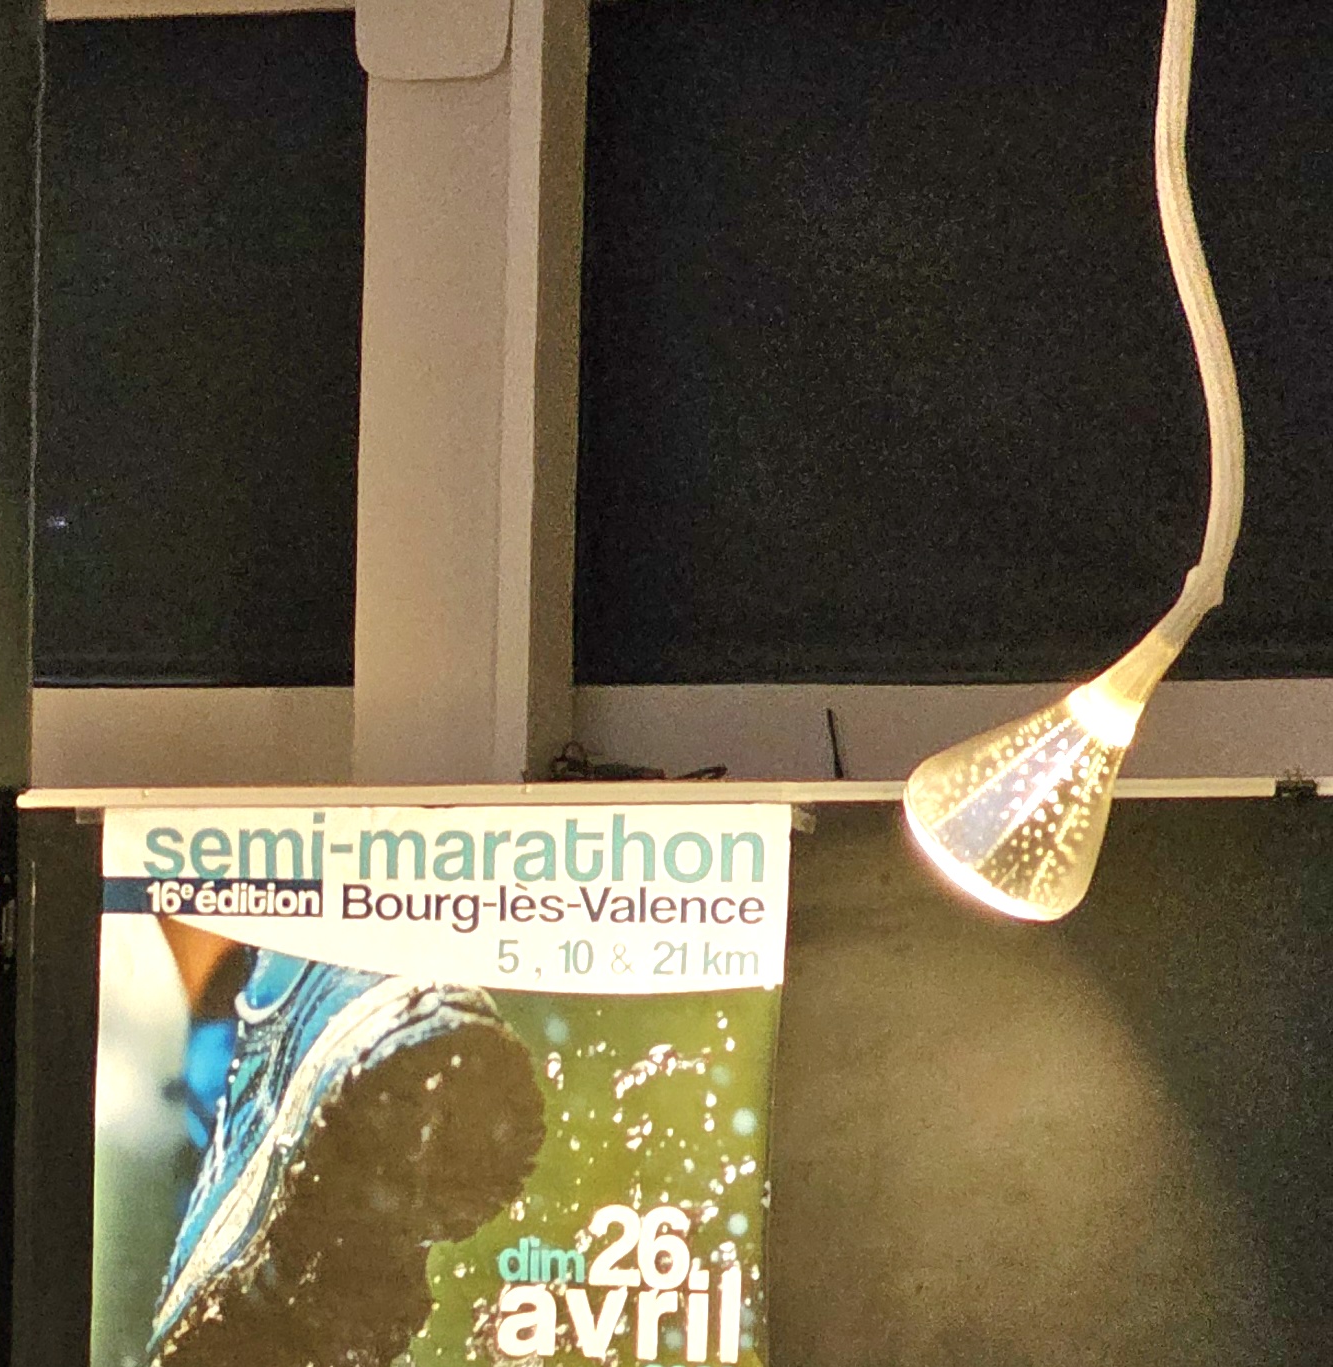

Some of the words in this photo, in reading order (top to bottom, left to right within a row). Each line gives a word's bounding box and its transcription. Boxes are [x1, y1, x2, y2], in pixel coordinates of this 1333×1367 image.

[143, 812, 764, 882] semi-marathon
[342, 883, 764, 930] Bourg-lès-Valence
[701, 943, 760, 975] km
[497, 1236, 586, 1282] dim
[587, 1204, 691, 1288] 26
[497, 1266, 741, 1364] avril
